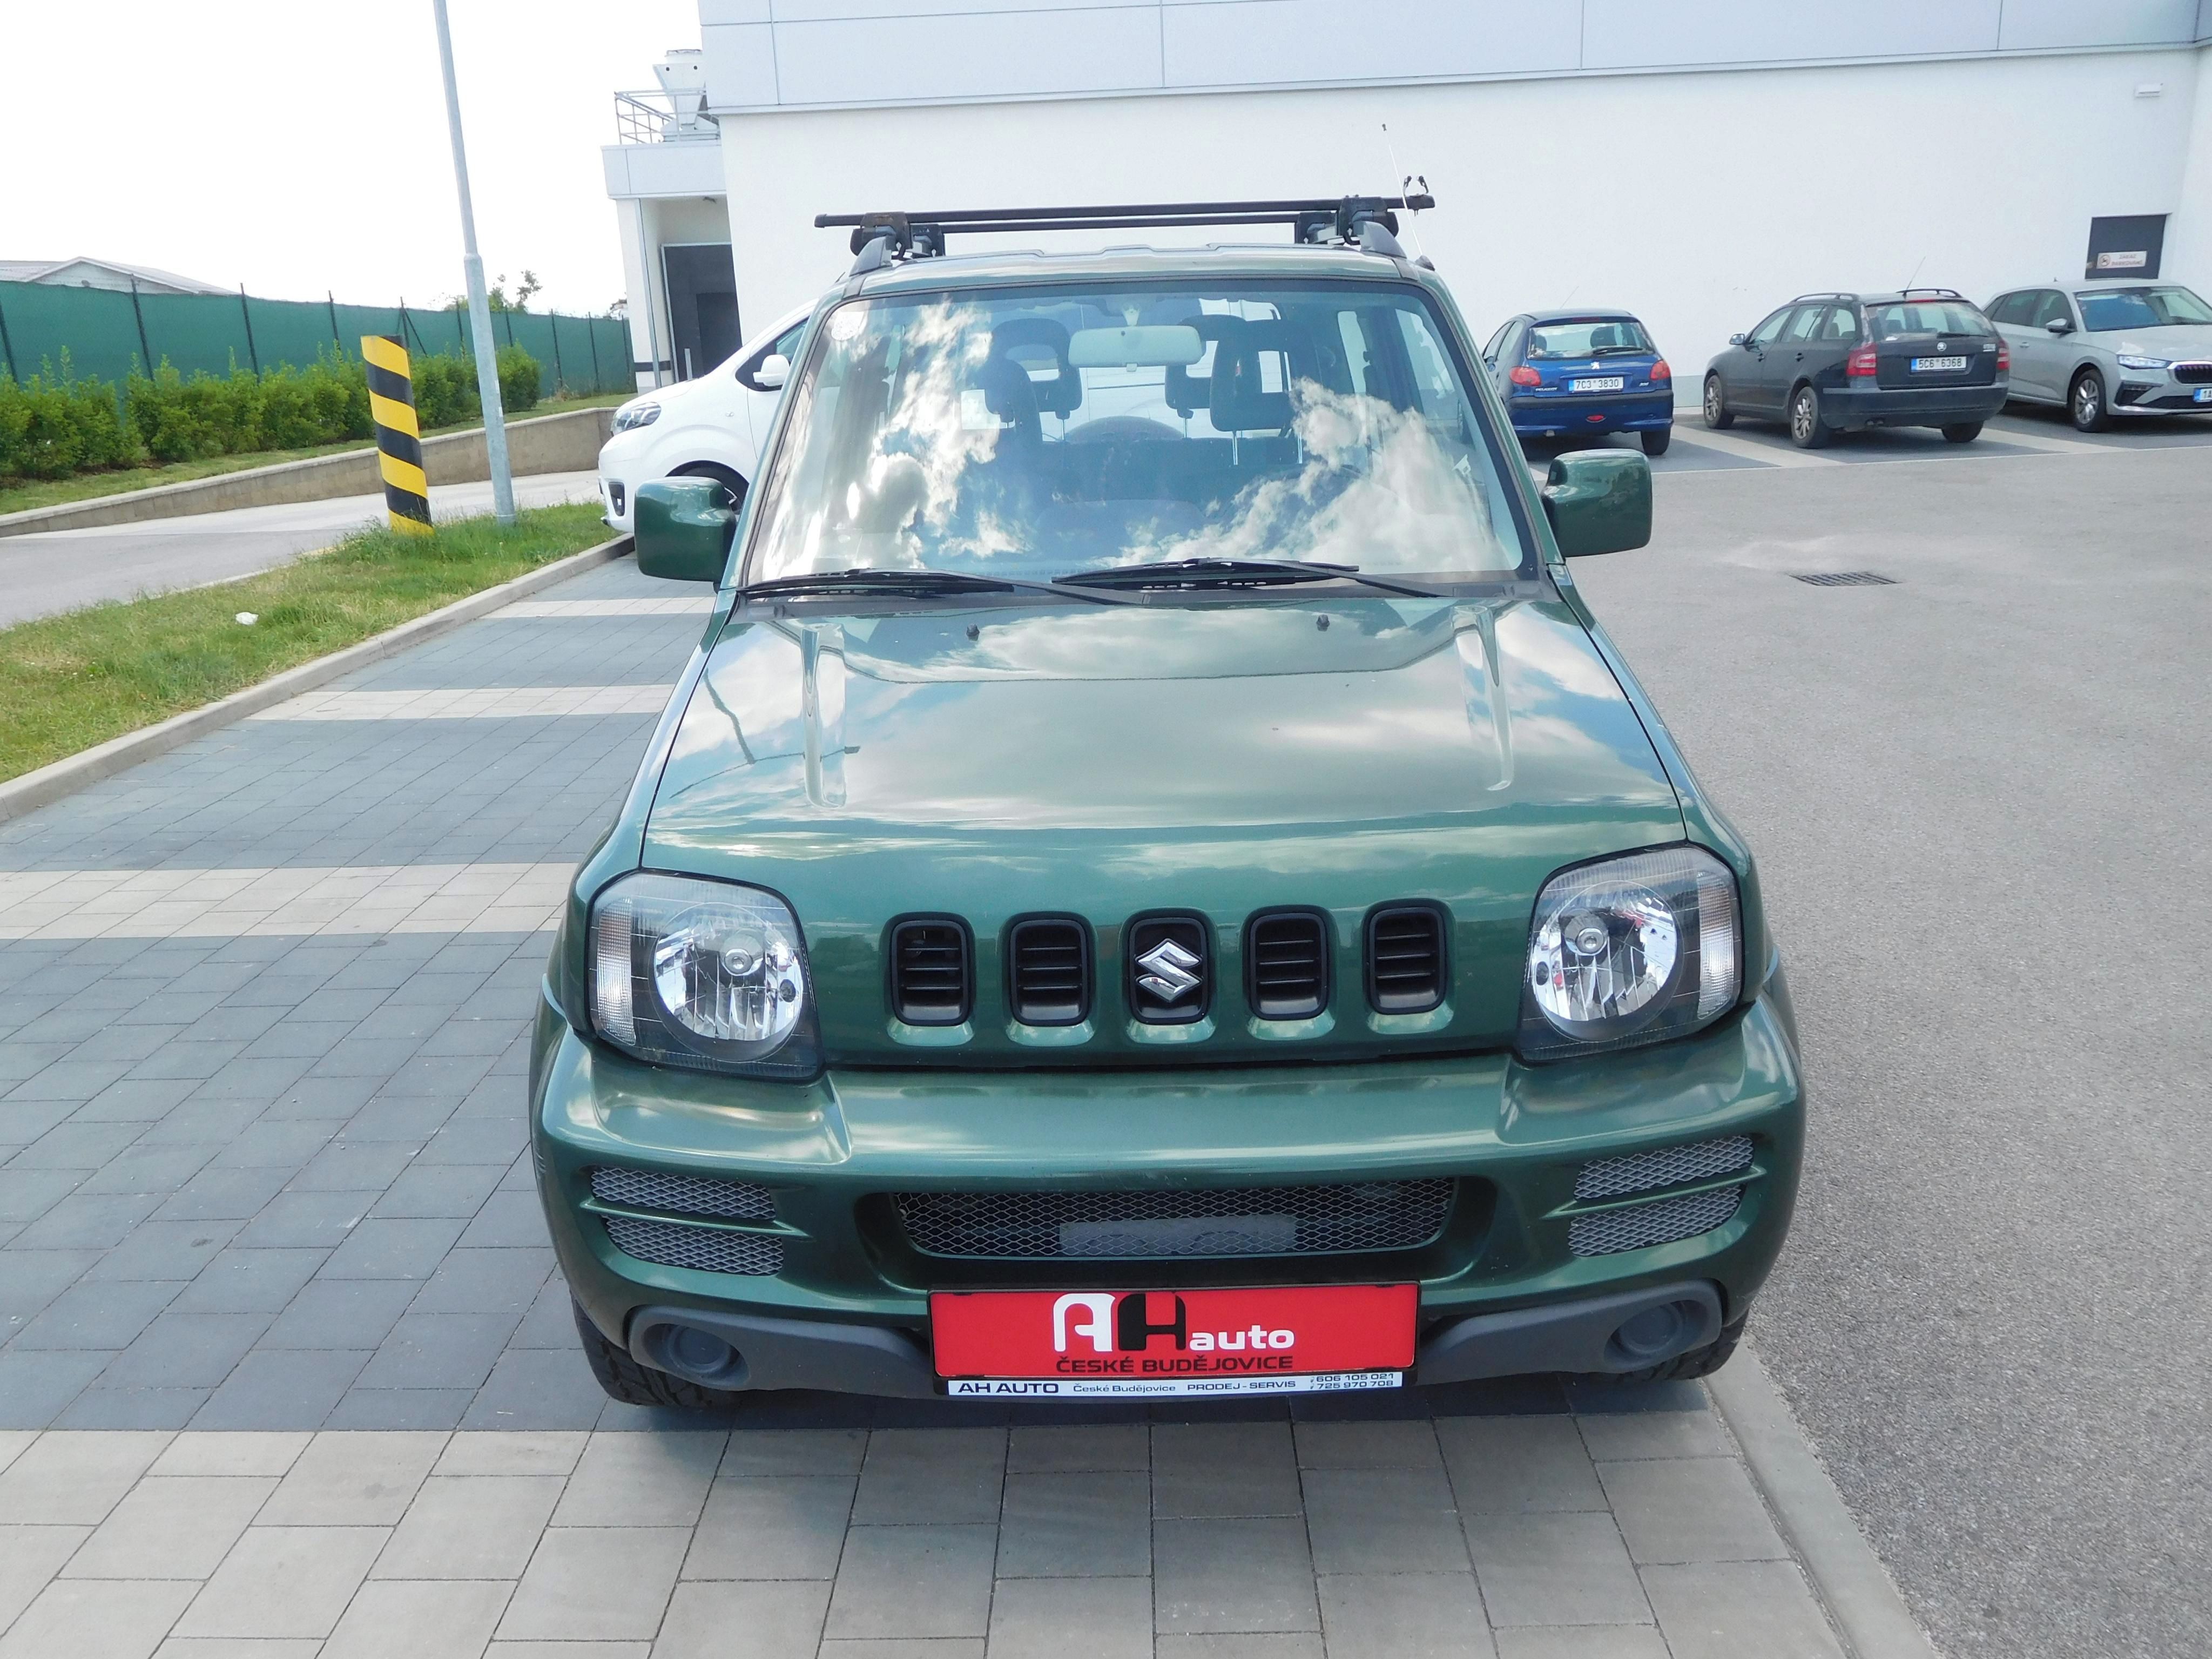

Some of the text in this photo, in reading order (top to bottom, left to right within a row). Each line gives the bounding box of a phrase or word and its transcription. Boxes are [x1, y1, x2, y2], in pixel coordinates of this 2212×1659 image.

[1919, 358, 1962, 368] 5C6 6368
[1576, 379, 1619, 389] 7C3 3830
[1056, 1354, 1294, 1373] ČESKÉ BUDĚJOVICE
[958, 1382, 991, 1393] AH
[996, 1382, 1059, 1393] AUTO
[1073, 1382, 1110, 1392] České
[1112, 1384, 1176, 1393] Budějovice
[1188, 1382, 1240, 1391] PRODEJ
[1249, 1380, 1296, 1389] SERVIS
